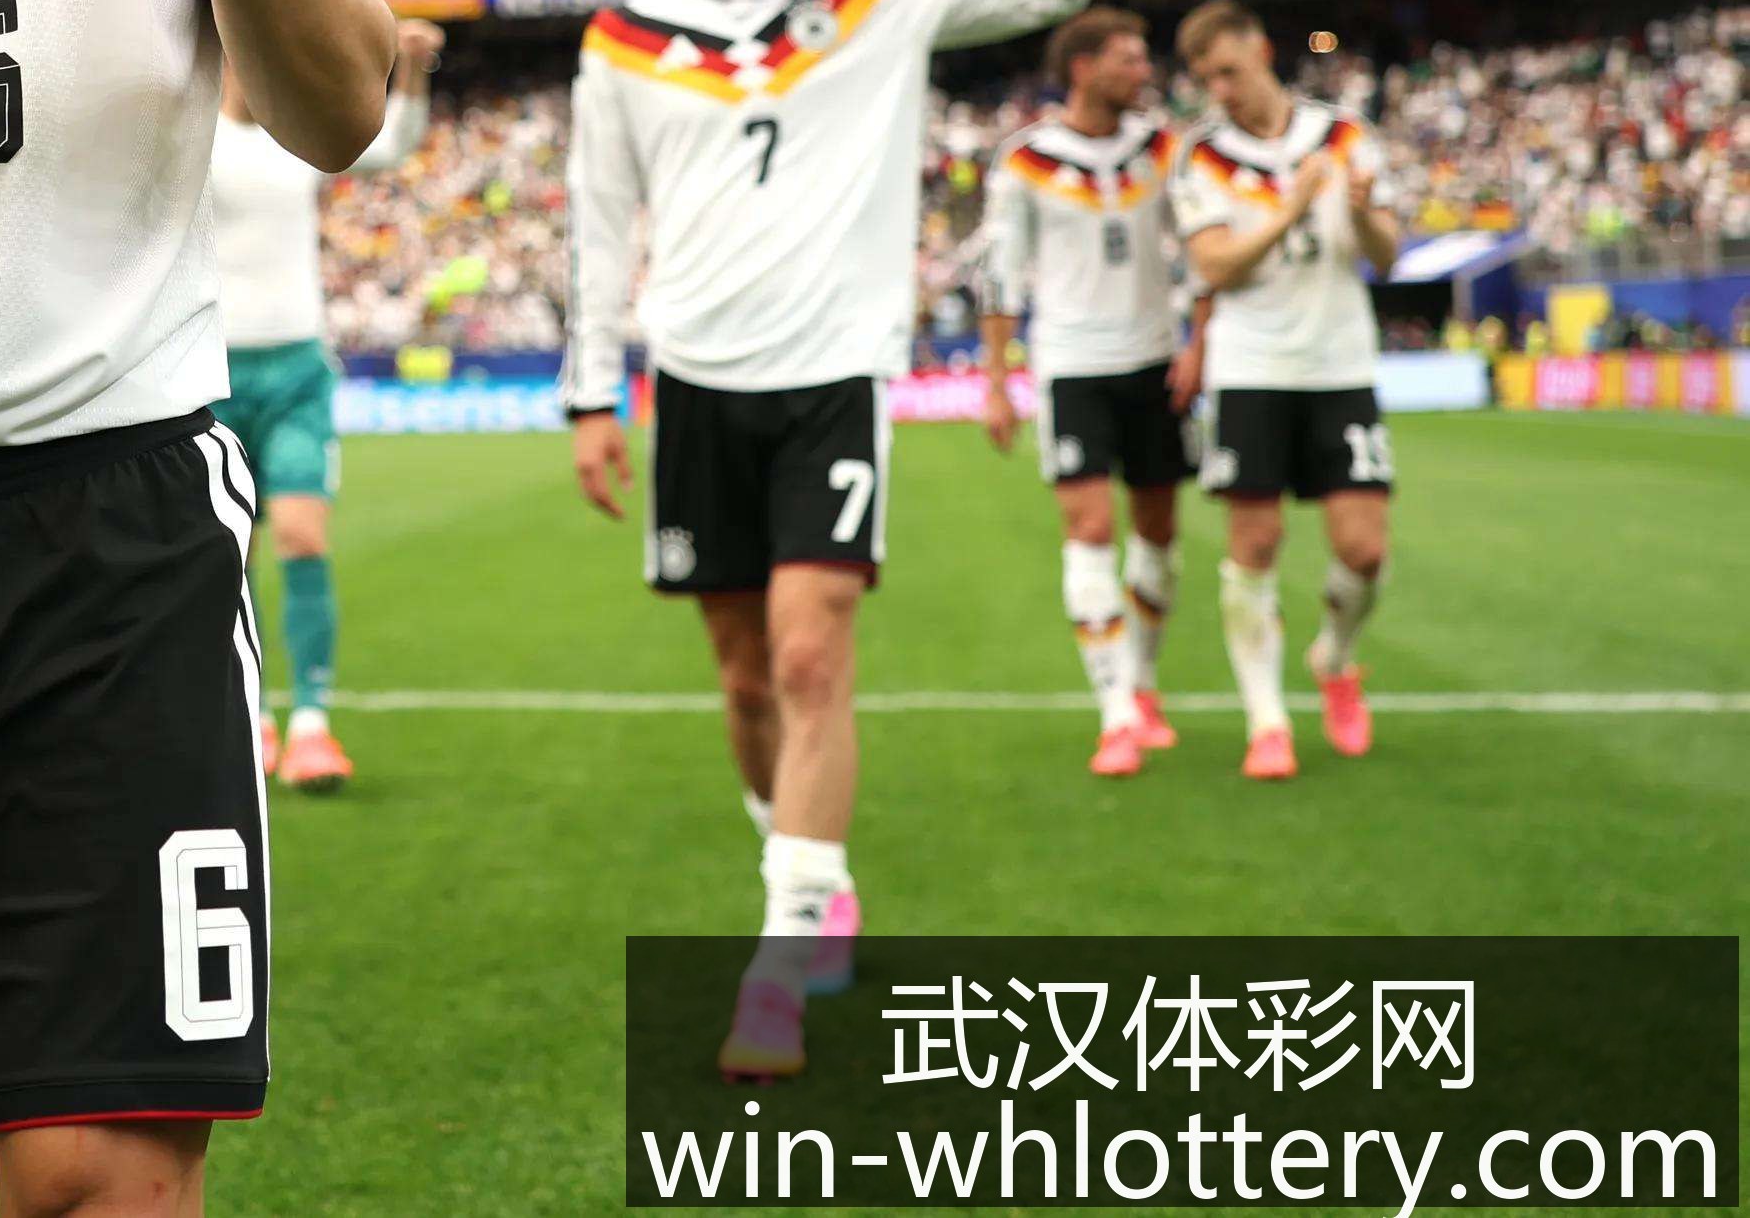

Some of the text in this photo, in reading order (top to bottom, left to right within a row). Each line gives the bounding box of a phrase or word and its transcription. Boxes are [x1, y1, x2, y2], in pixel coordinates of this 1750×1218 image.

[744, 118, 778, 184] 7
[828, 460, 875, 543] 7
[159, 828, 254, 1042] 6
